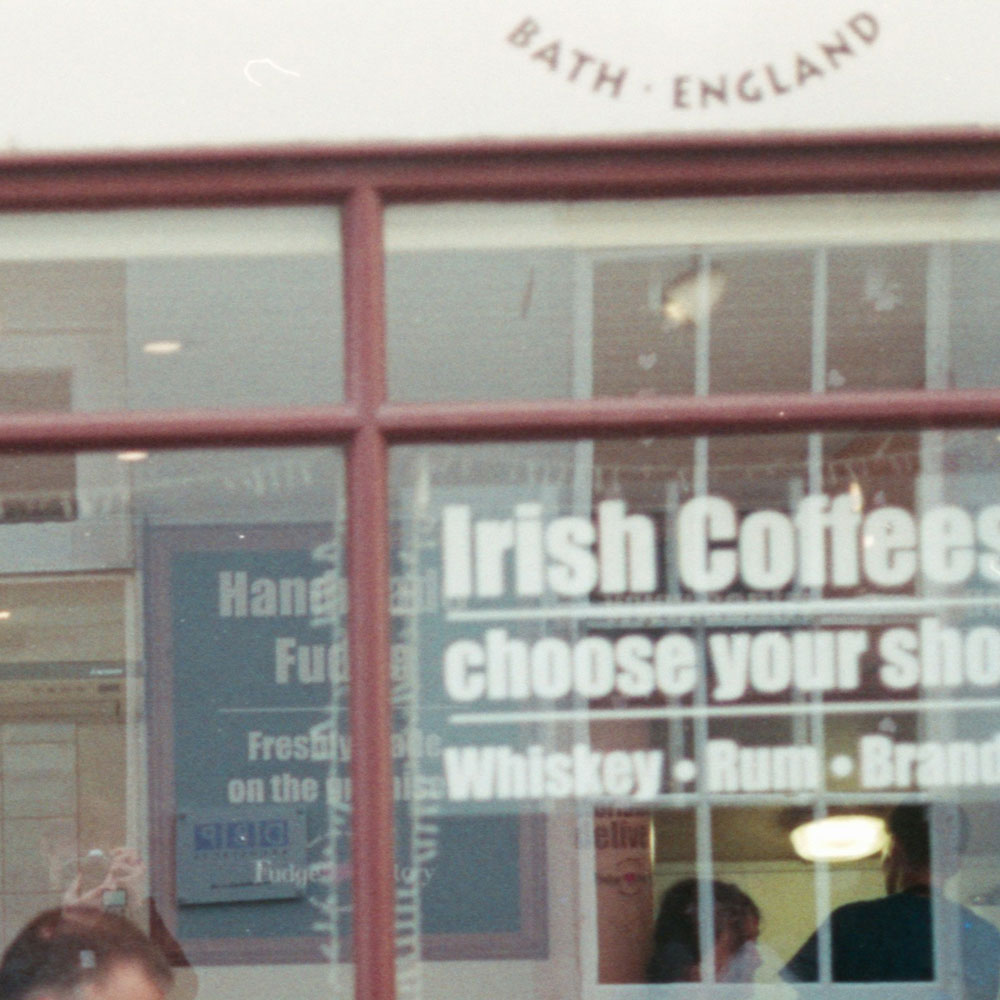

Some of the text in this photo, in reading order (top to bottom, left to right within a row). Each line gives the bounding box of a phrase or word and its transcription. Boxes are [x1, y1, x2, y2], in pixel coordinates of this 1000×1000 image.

[507, 11, 880, 108] BATH ENGLAND
[442, 499, 657, 599] Irish
[444, 629, 697, 701] choose
[709, 630, 868, 701] your
[227, 778, 265, 804] on
[269, 773, 319, 803] the
[444, 743, 664, 801] Whiskey
[704, 739, 822, 792] Rum
